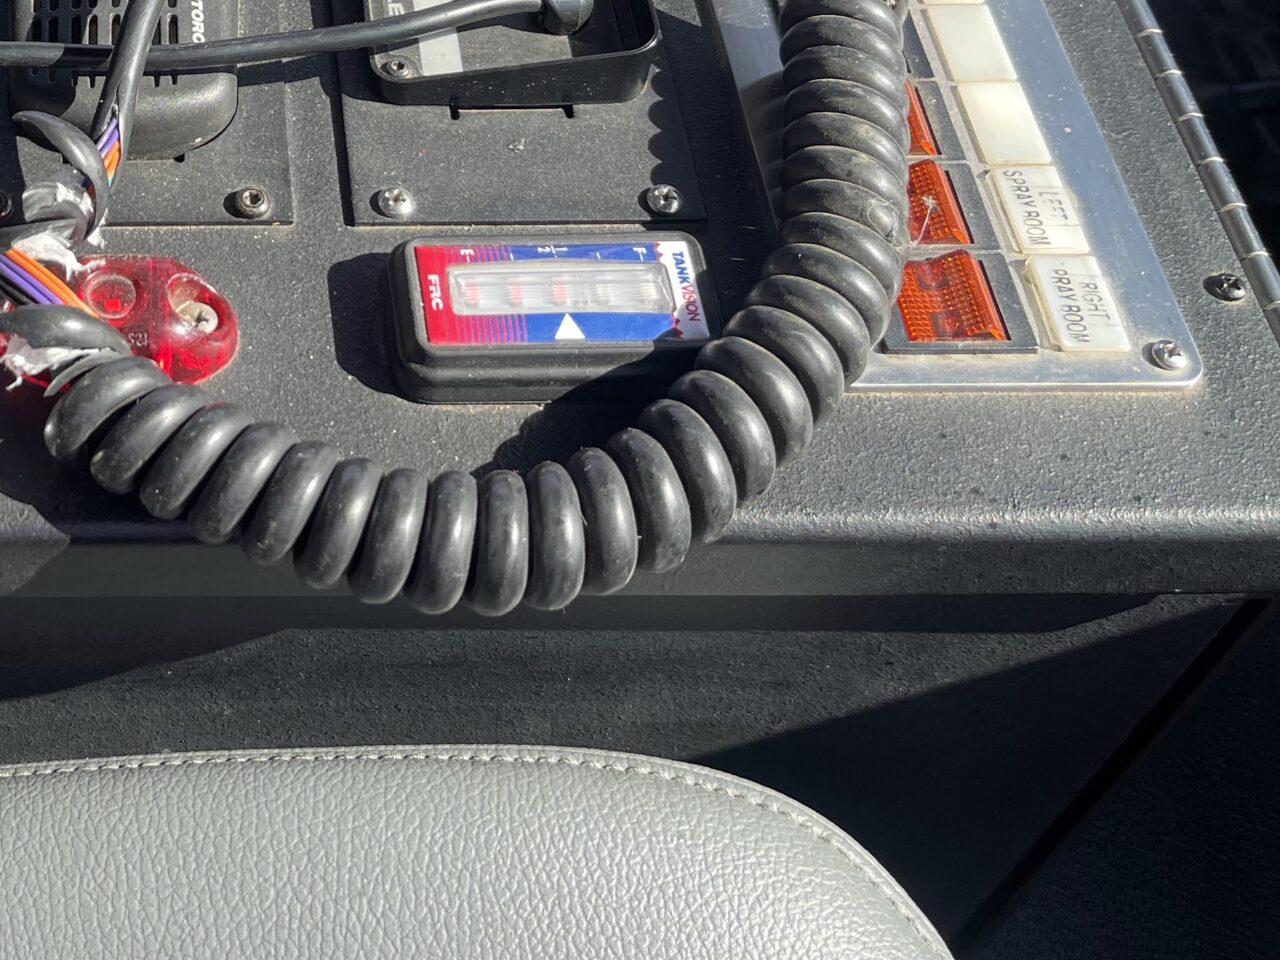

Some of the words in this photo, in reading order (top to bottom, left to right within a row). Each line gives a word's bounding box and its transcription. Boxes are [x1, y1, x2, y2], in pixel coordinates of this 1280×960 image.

[1003, 170, 1037, 208] SPRAY
[1039, 191, 1068, 221] LEFT
[426, 274, 444, 312] FRC
[672, 251, 702, 322] TANKVISION
[1051, 261, 1079, 302] PRAY
[1079, 282, 1110, 321] RIGHT
